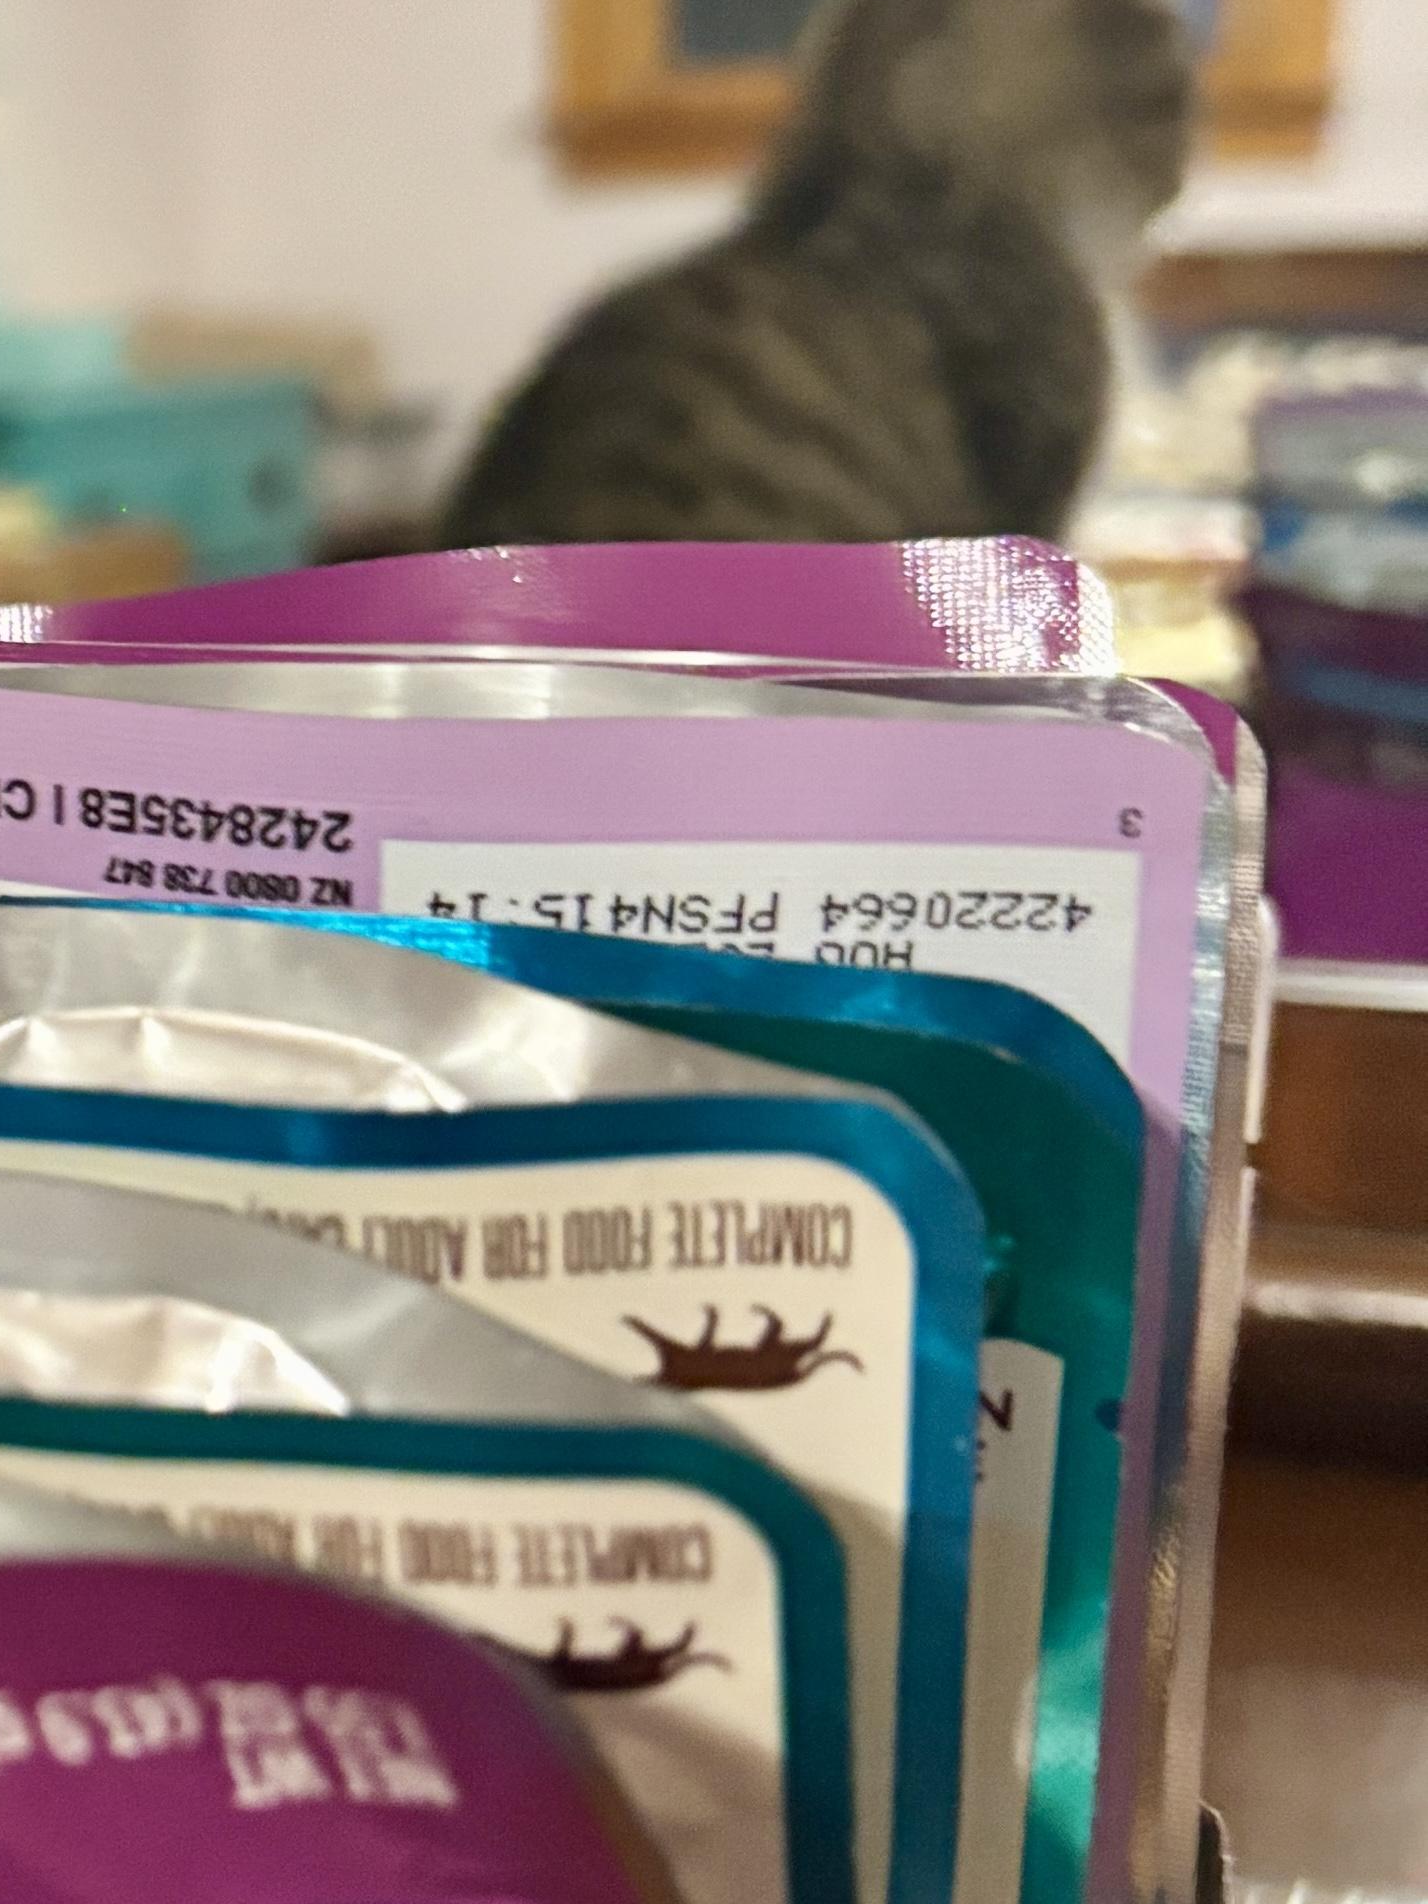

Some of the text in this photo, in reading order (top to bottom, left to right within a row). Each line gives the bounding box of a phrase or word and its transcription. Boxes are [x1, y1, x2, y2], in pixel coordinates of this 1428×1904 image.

[81, 786, 354, 853] 2428435E8
[1119, 807, 1145, 840] 3
[164, 862, 218, 897] 738
[225, 871, 301, 904] 0800
[311, 877, 353, 907] NZ
[819, 894, 1094, 934] 42220664
[482, 1211, 550, 1281] FOR
[562, 1207, 652, 1274] FOOD
[673, 1200, 854, 1271] COMPLETE
[518, 1523, 715, 1586] COMPLETE
